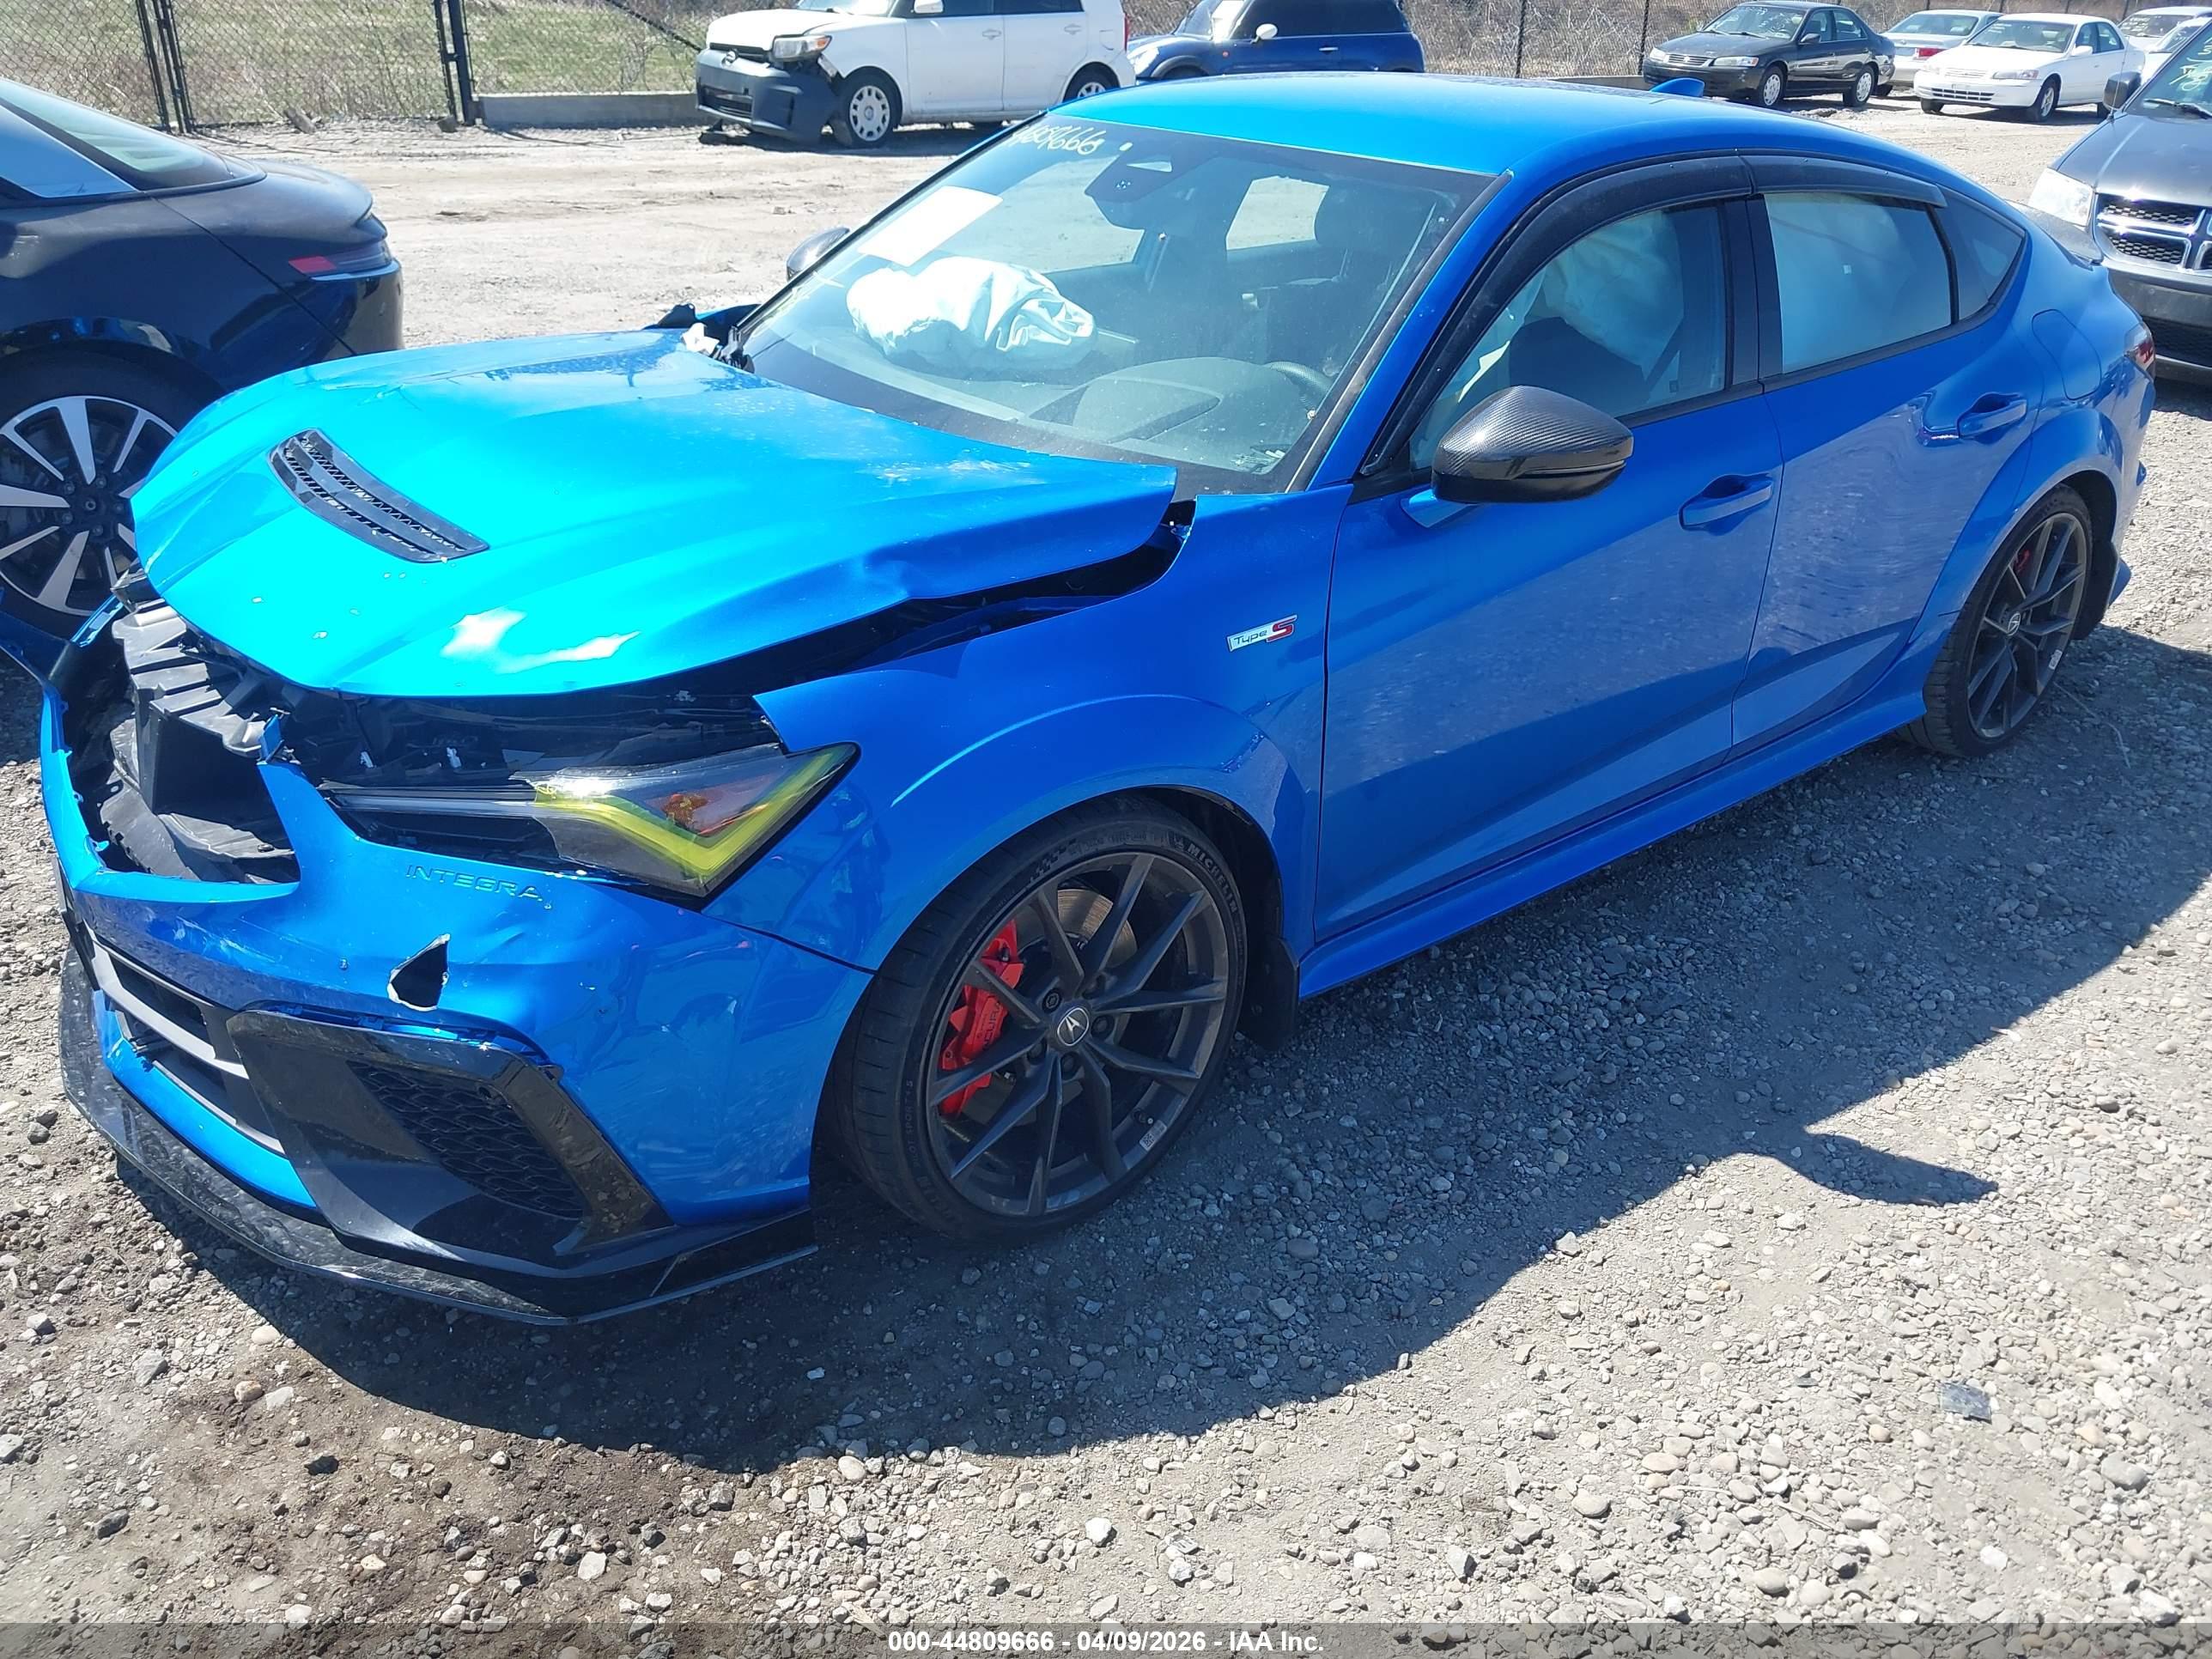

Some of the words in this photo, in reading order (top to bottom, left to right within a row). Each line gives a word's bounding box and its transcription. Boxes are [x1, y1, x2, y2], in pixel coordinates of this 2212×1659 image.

[1233, 630, 1267, 645] Type
[1265, 615, 1297, 643] S
[404, 864, 544, 902] INTEGRA
[1188, 843, 1237, 913] MICHELIN
